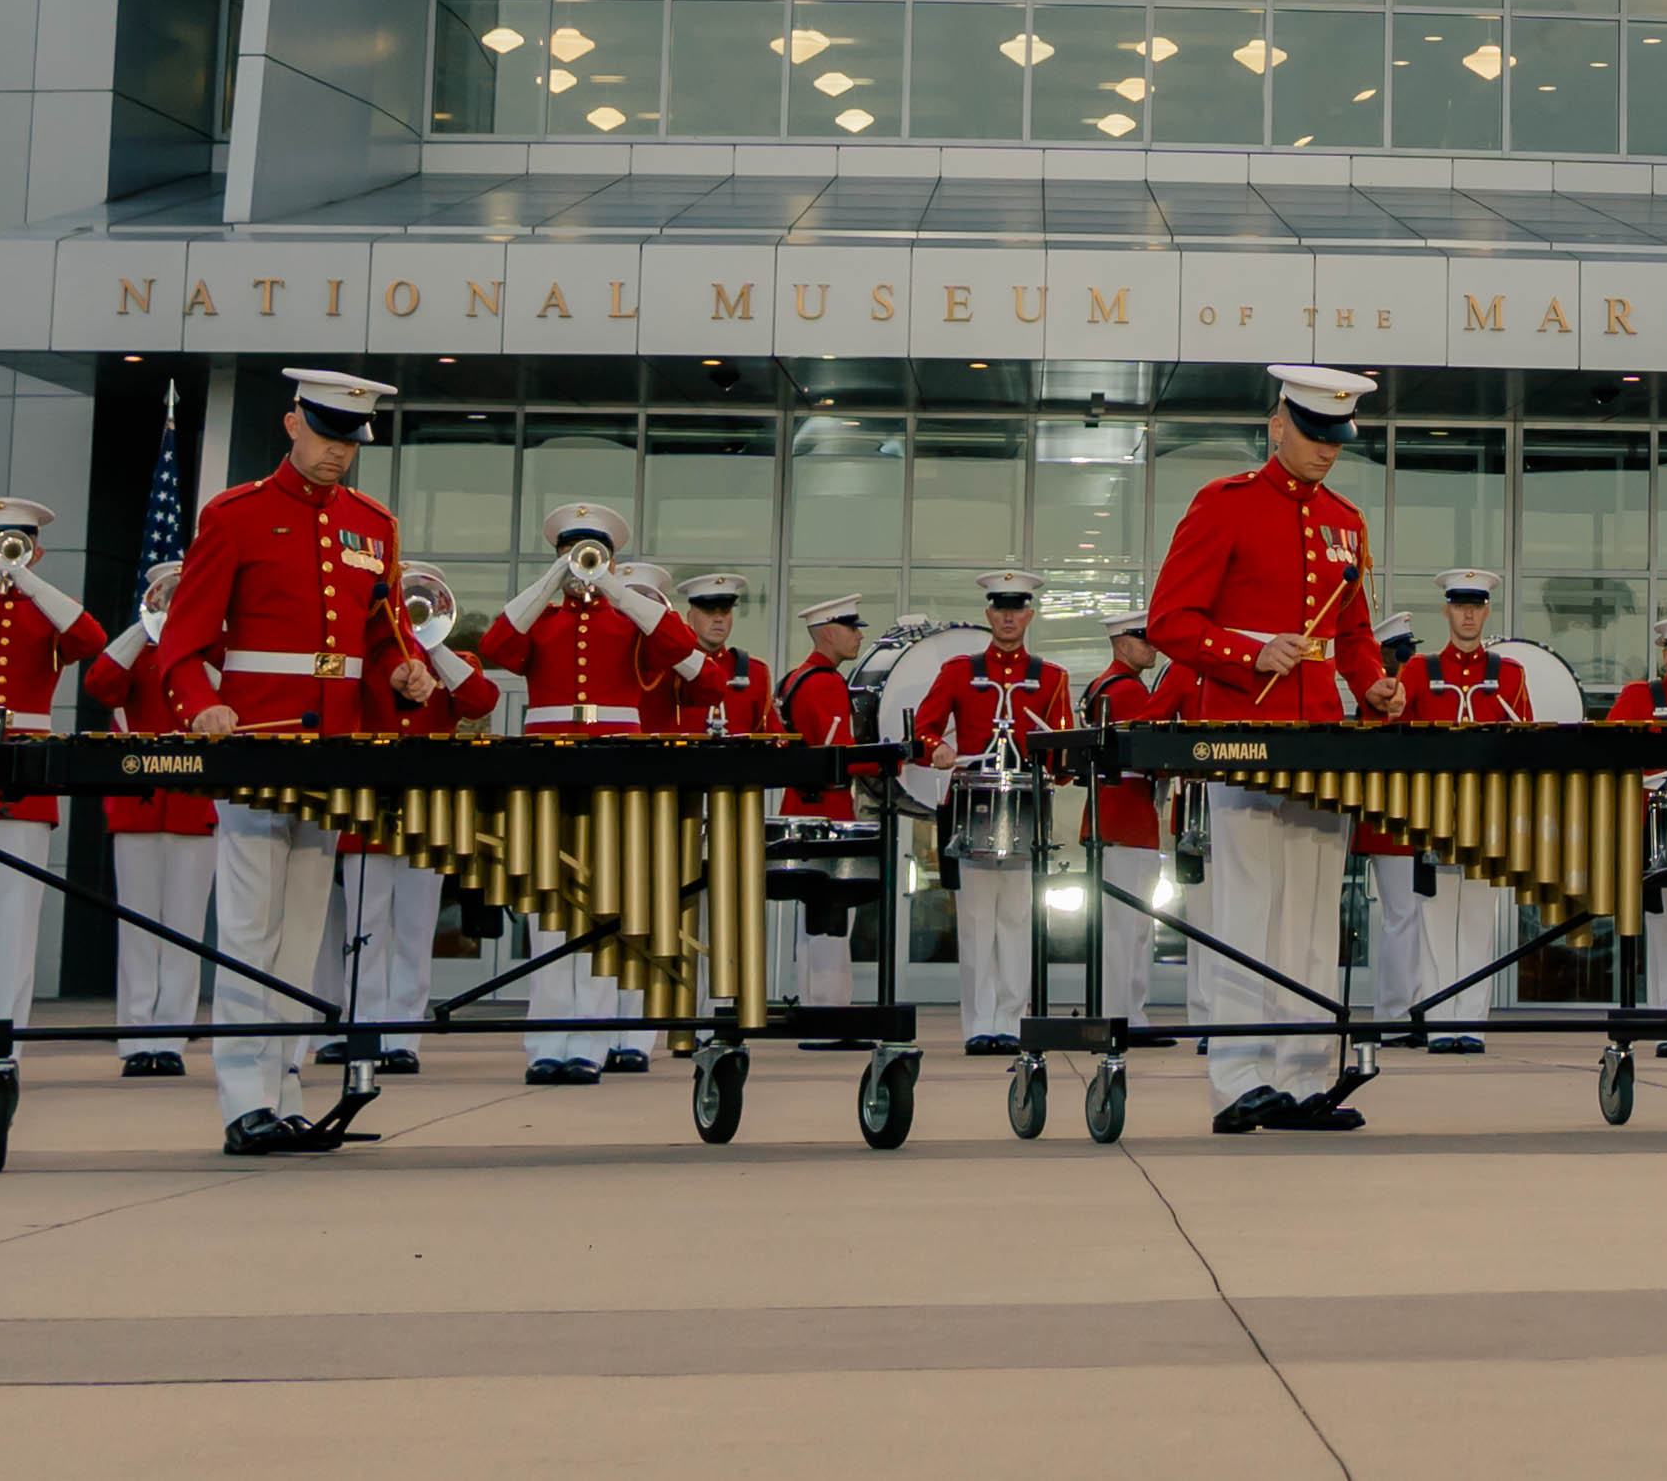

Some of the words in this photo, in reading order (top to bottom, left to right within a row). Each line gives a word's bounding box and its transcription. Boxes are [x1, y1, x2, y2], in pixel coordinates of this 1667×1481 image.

[116, 276, 639, 320] NATIONAL
[711, 280, 1133, 326] MUSEUM
[1198, 304, 1255, 327] OF
[1301, 306, 1393, 330] THE
[1211, 742, 1268, 760] YAMAHA
[141, 755, 203, 773] YAMAHA
